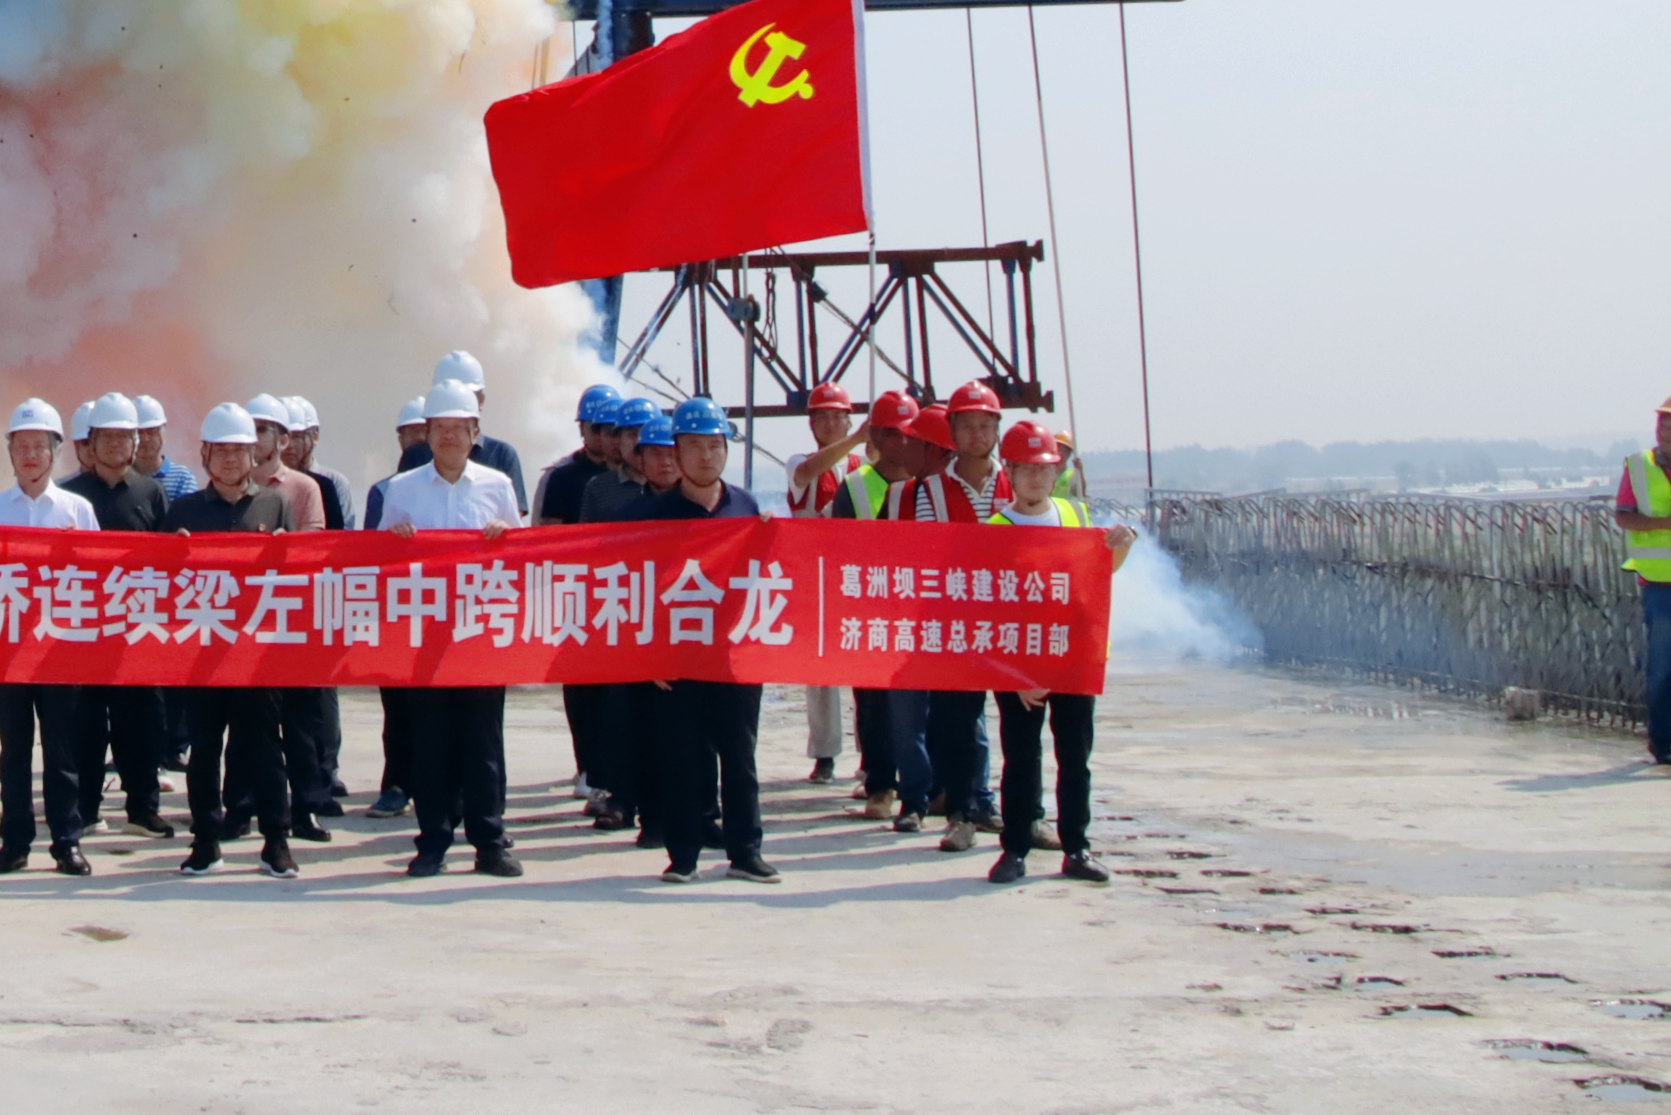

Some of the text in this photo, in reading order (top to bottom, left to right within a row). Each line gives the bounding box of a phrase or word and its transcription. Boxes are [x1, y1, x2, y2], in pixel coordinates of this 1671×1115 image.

[840, 564, 1071, 605] 葛洲坝三峡建设公司
[840, 617, 1070, 658] 济商高速总承项目部
